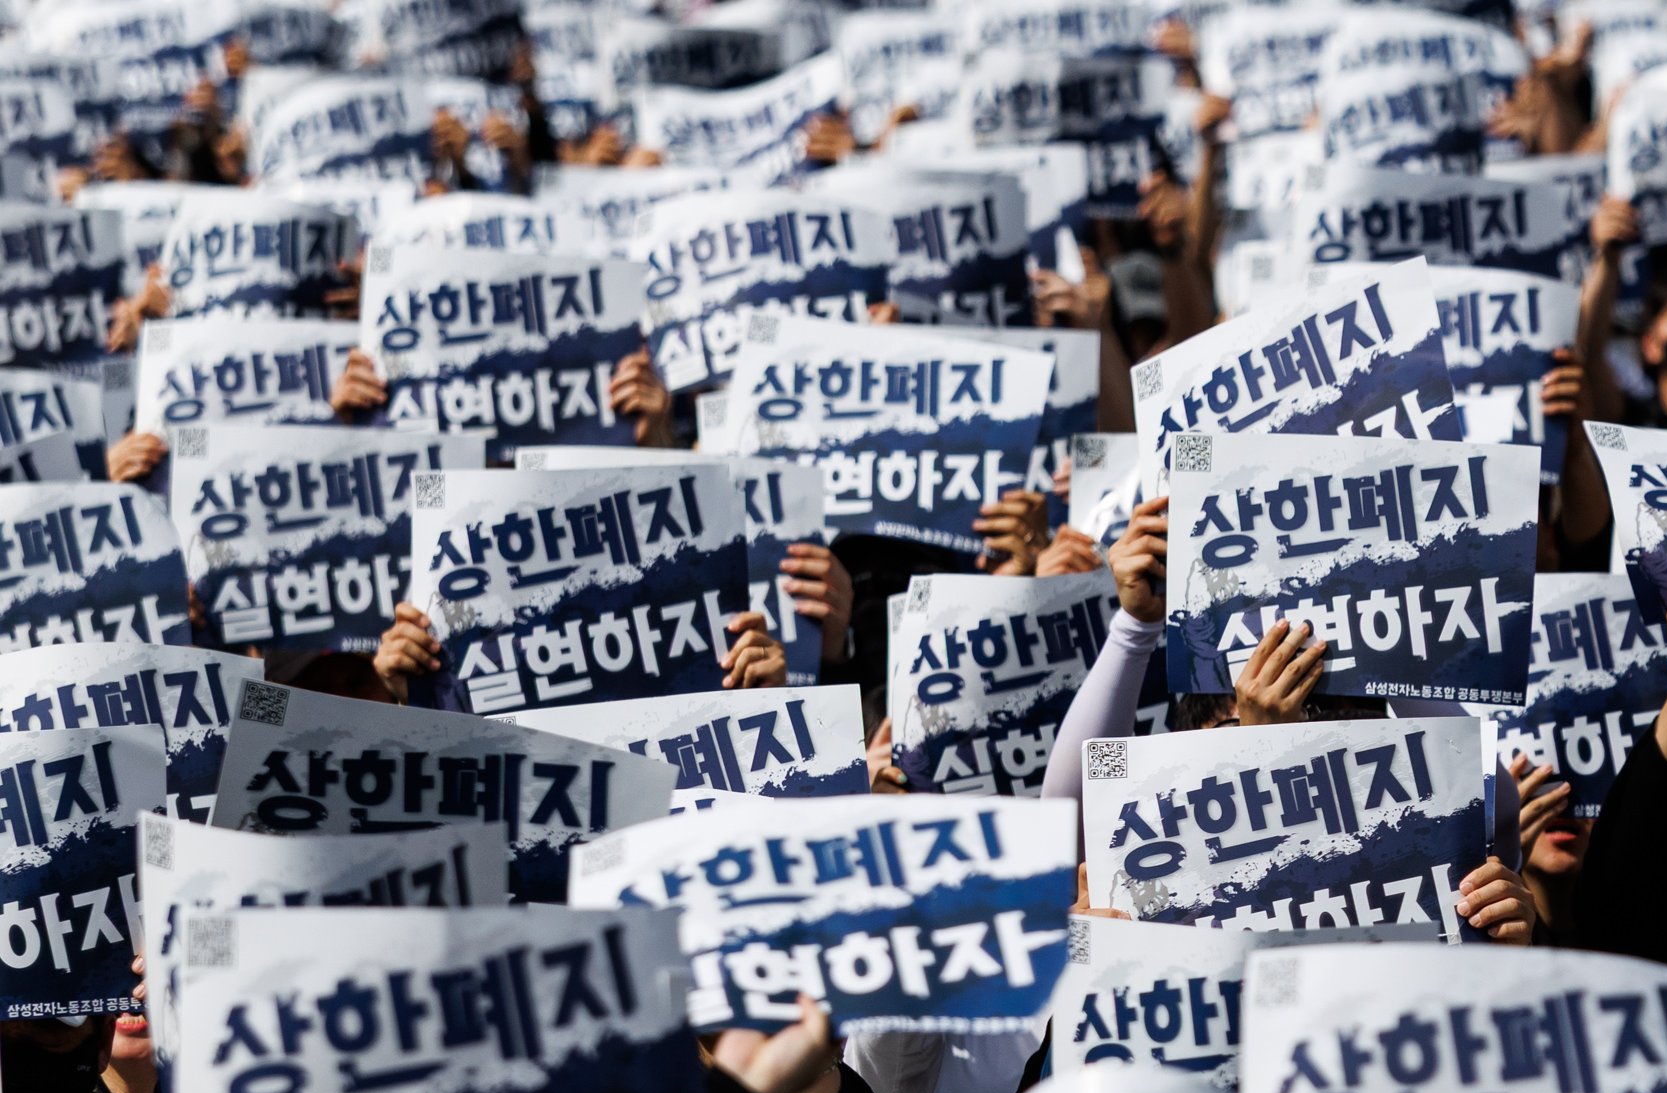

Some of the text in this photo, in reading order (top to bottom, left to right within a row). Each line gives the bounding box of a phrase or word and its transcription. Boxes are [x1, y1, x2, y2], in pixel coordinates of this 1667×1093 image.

[0, 214, 92, 270] 폐지
[170, 216, 347, 290] 상한폐지
[647, 211, 852, 300] 상한폐지
[893, 198, 998, 264] 폐지
[1310, 189, 1528, 262] 상한폐지
[0, 292, 108, 352] 하자
[378, 267, 606, 352] 상한폐지
[1437, 285, 1541, 352] 폐지
[160, 345, 338, 423] 상한폐
[388, 360, 616, 428] 실현하자
[752, 357, 1006, 422] 상한폐지
[1157, 282, 1396, 464] 상한폐지
[800, 450, 1032, 514] 현하자
[1192, 455, 1490, 572] 상한폐지
[0, 495, 144, 578] 폐지
[432, 474, 704, 602] 상한폐지
[213, 553, 408, 644] 실현하
[1217, 577, 1530, 682] 실현하자
[458, 588, 742, 715] 실현하자
[912, 596, 1124, 705] 상한폐
[0, 661, 230, 736] 한폐지
[1365, 681, 1524, 705] 삼성전자노동조합 공동투쟁본부
[628, 698, 819, 796] 폐지
[930, 718, 1055, 803] 실현
[246, 748, 617, 832] 상한폐지
[1108, 730, 1434, 881] 상한폐지
[0, 872, 140, 974] 하자
[8, 999, 105, 1018] 삼성전자노동조합
[1072, 975, 1240, 1076] 상한
